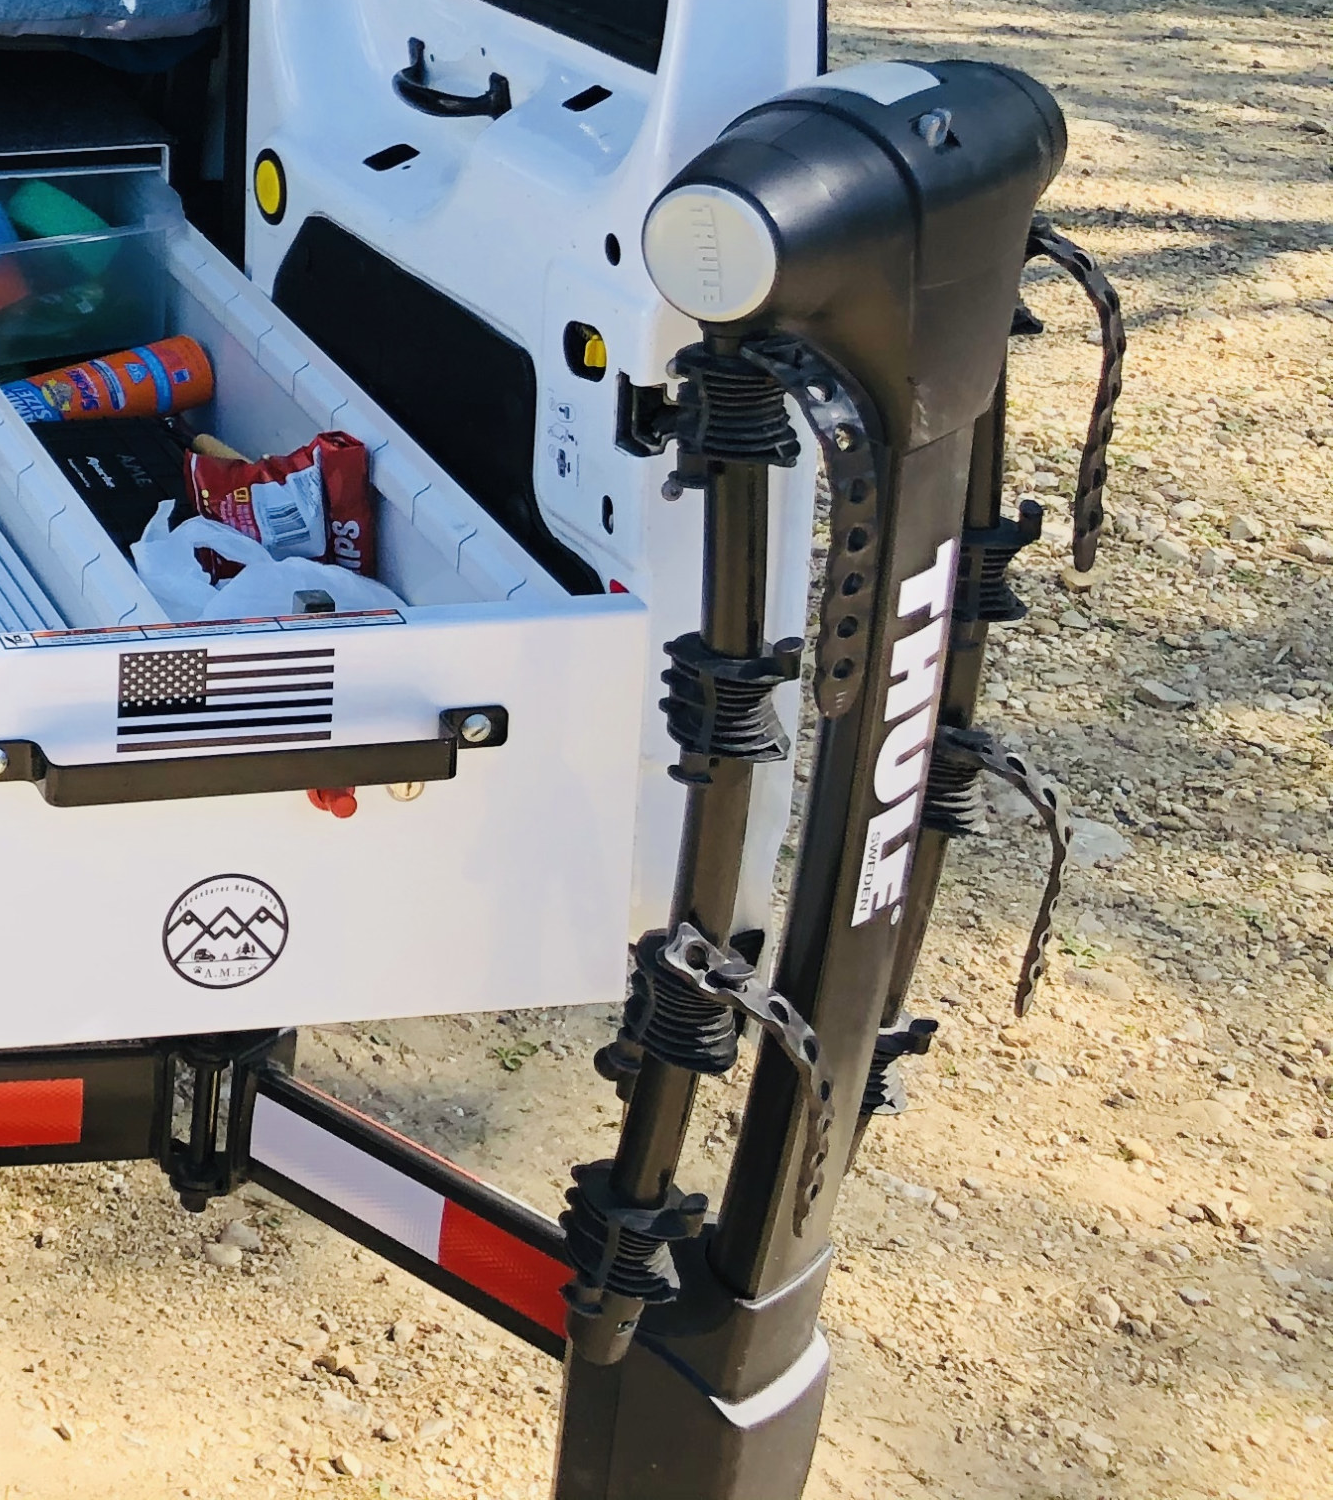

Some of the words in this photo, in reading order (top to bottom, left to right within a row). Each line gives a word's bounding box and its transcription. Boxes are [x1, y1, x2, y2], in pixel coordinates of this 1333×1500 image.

[12, 387, 53, 420] SIZE!
[332, 520, 362, 572] ips
[850, 538, 956, 928] THULE
[858, 830, 882, 913] SWEDEN
